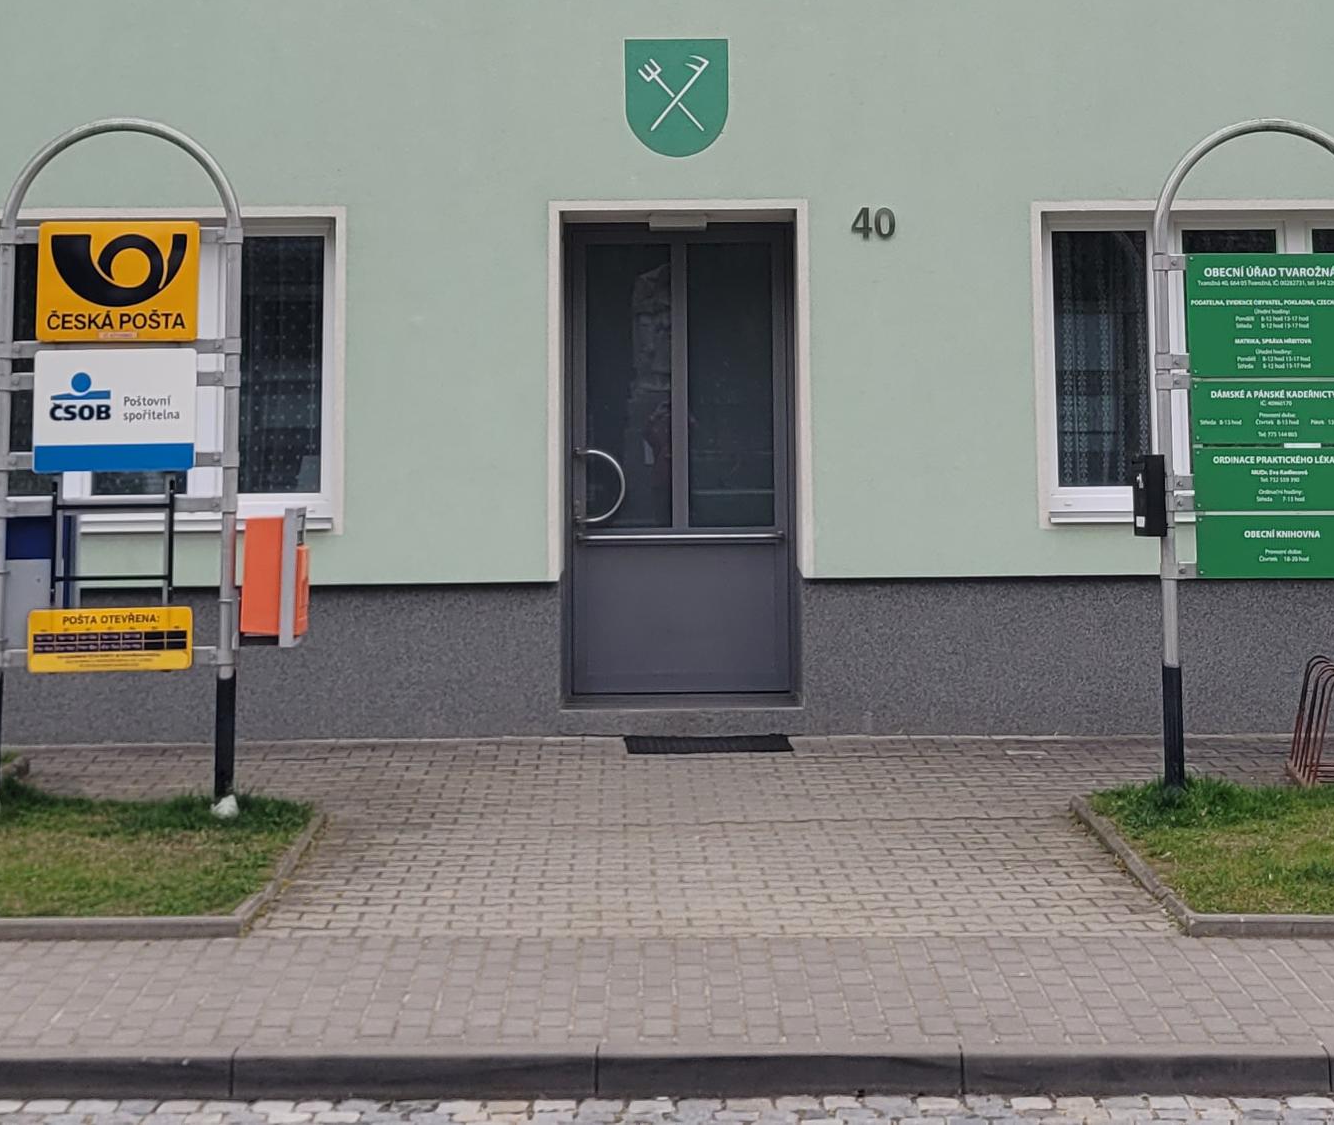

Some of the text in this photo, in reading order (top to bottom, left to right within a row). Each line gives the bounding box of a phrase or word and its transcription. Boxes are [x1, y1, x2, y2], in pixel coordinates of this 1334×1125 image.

[851, 207, 897, 240] 40
[1204, 265, 1244, 277] OBECNÍ
[1246, 265, 1276, 277] ÚŘAD
[47, 309, 186, 330] ČESKÁ POŠTA
[1210, 389, 1245, 398] DÁMSKÉ
[1246, 390, 1252, 398] A
[1253, 389, 1285, 398] PÁNSKÉ
[123, 395, 171, 407] Poštovní
[49, 402, 111, 421] ČSOB
[123, 410, 180, 423] spořitelna
[1213, 455, 1255, 464] ORDINACE
[1255, 455, 1313, 464] PRAKTICKÉHO
[1244, 529, 1321, 538] OBECNÍ KNIHOVNA
[62, 612, 160, 625] POŠTA OTEVŘENA:
